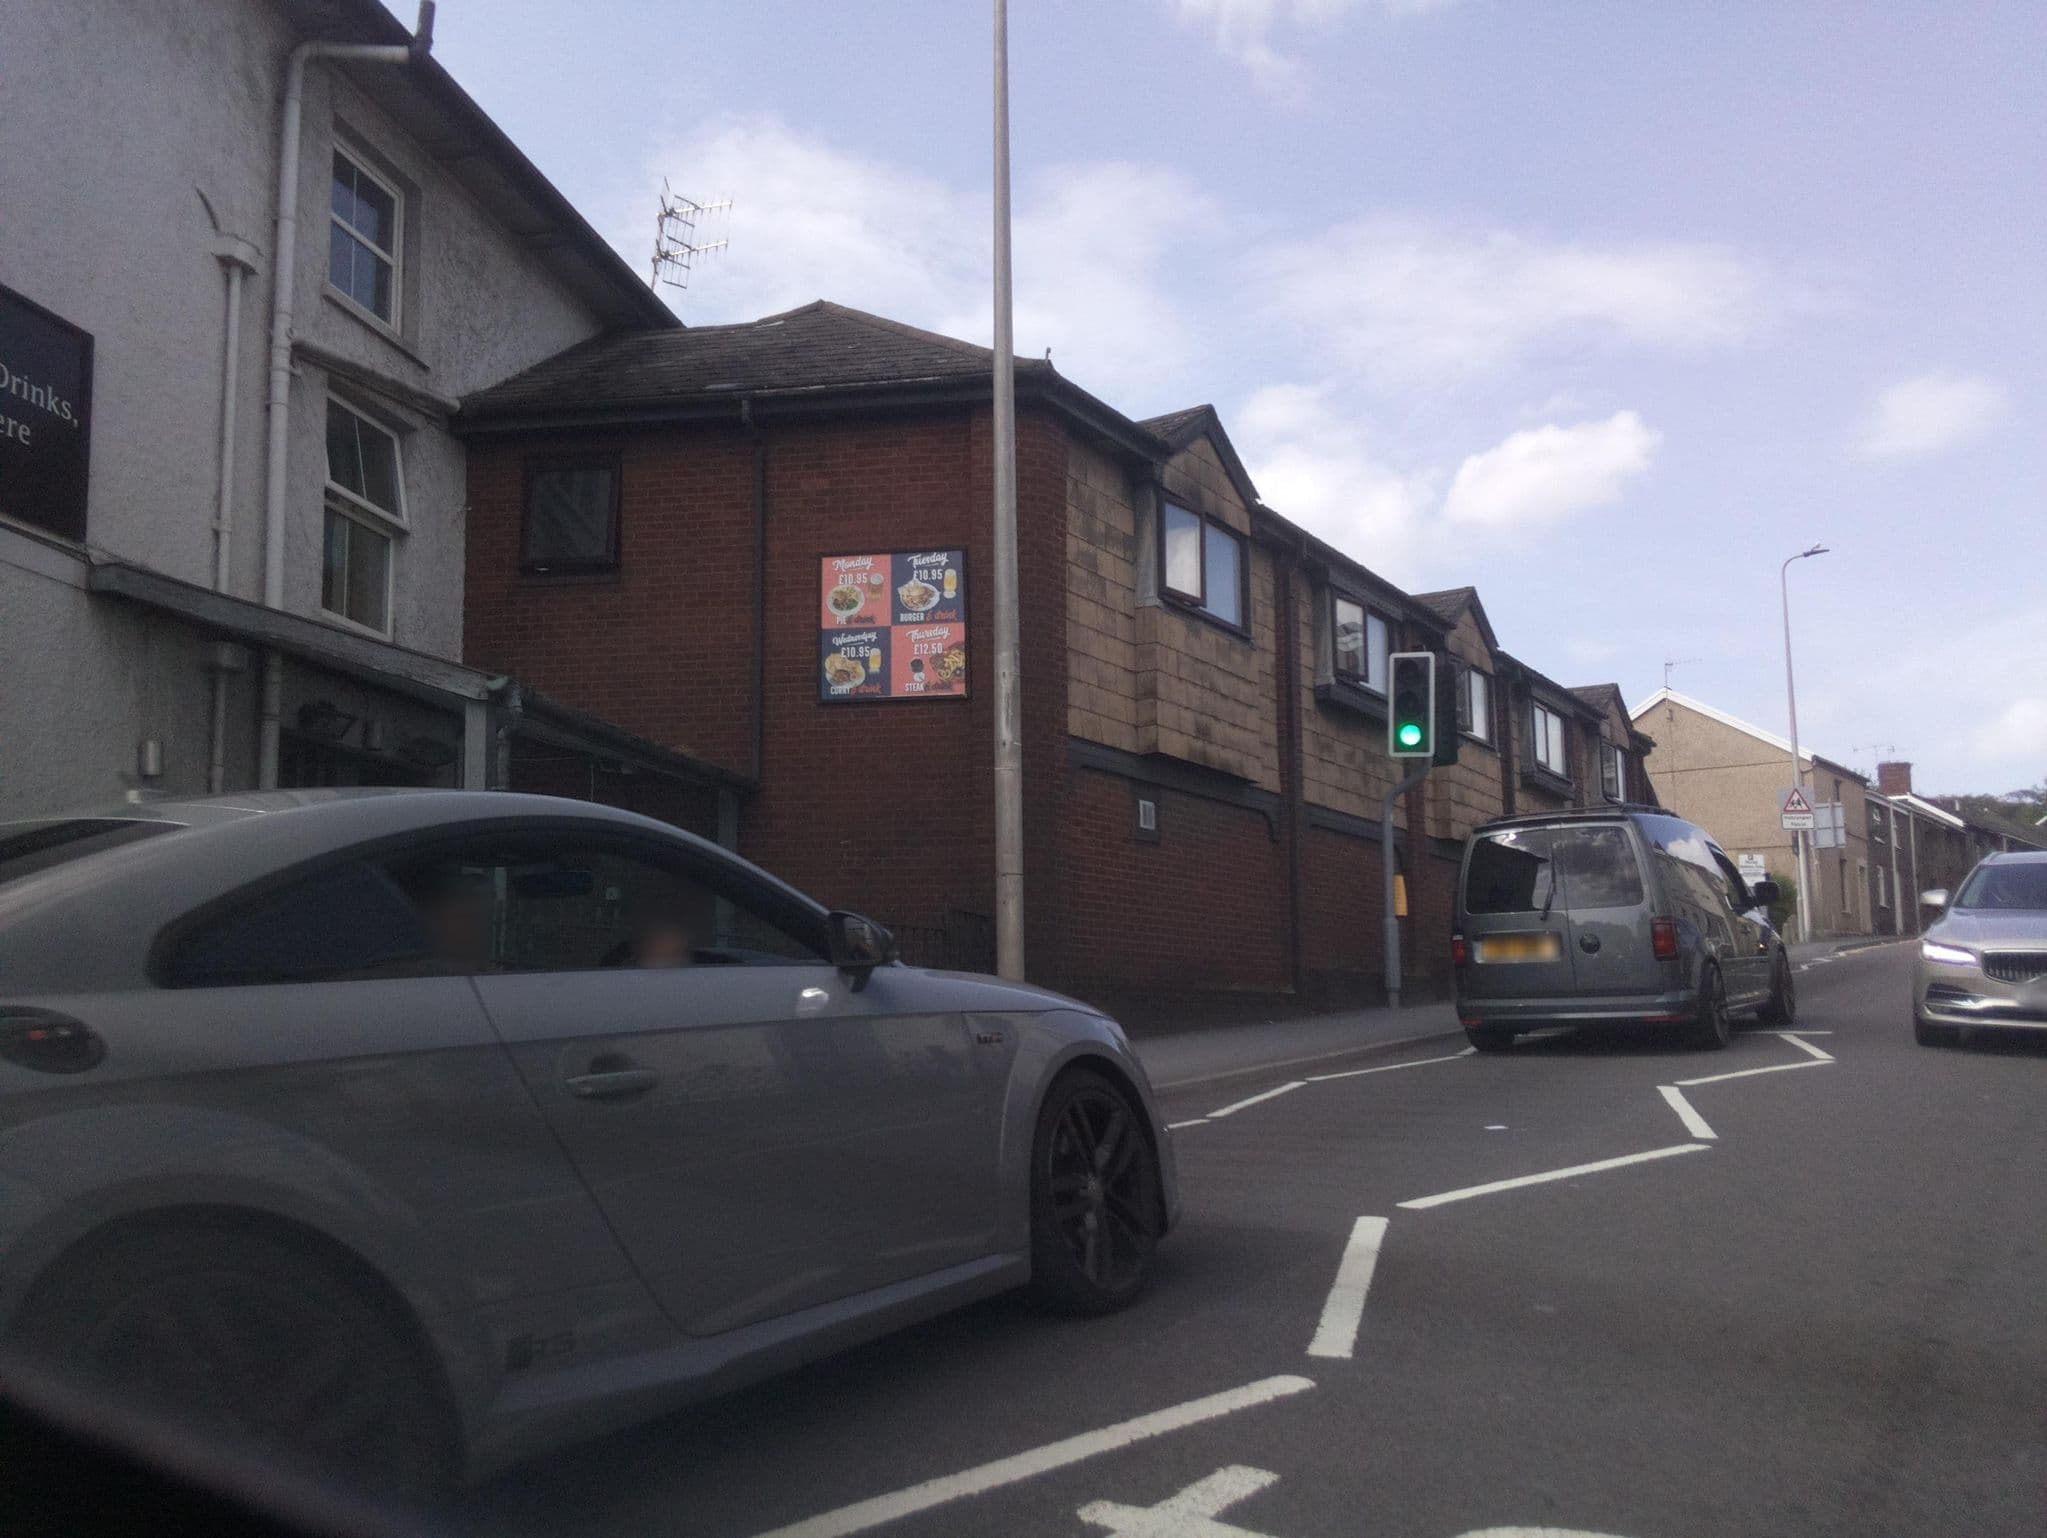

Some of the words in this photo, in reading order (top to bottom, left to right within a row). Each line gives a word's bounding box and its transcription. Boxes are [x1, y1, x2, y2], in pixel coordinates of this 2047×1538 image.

[832, 556, 875, 572] Monday
[907, 552, 949, 569] Tuesday
[839, 573, 868, 585] £10.95
[914, 569, 943, 580] £10.95
[900, 613, 925, 622] BURGER
[832, 632, 877, 646] Wednesday
[906, 626, 950, 642] Thursday
[841, 647, 870, 657] £10.95
[914, 643, 943, 655] £12.50
[905, 682, 924, 692] STEAK
